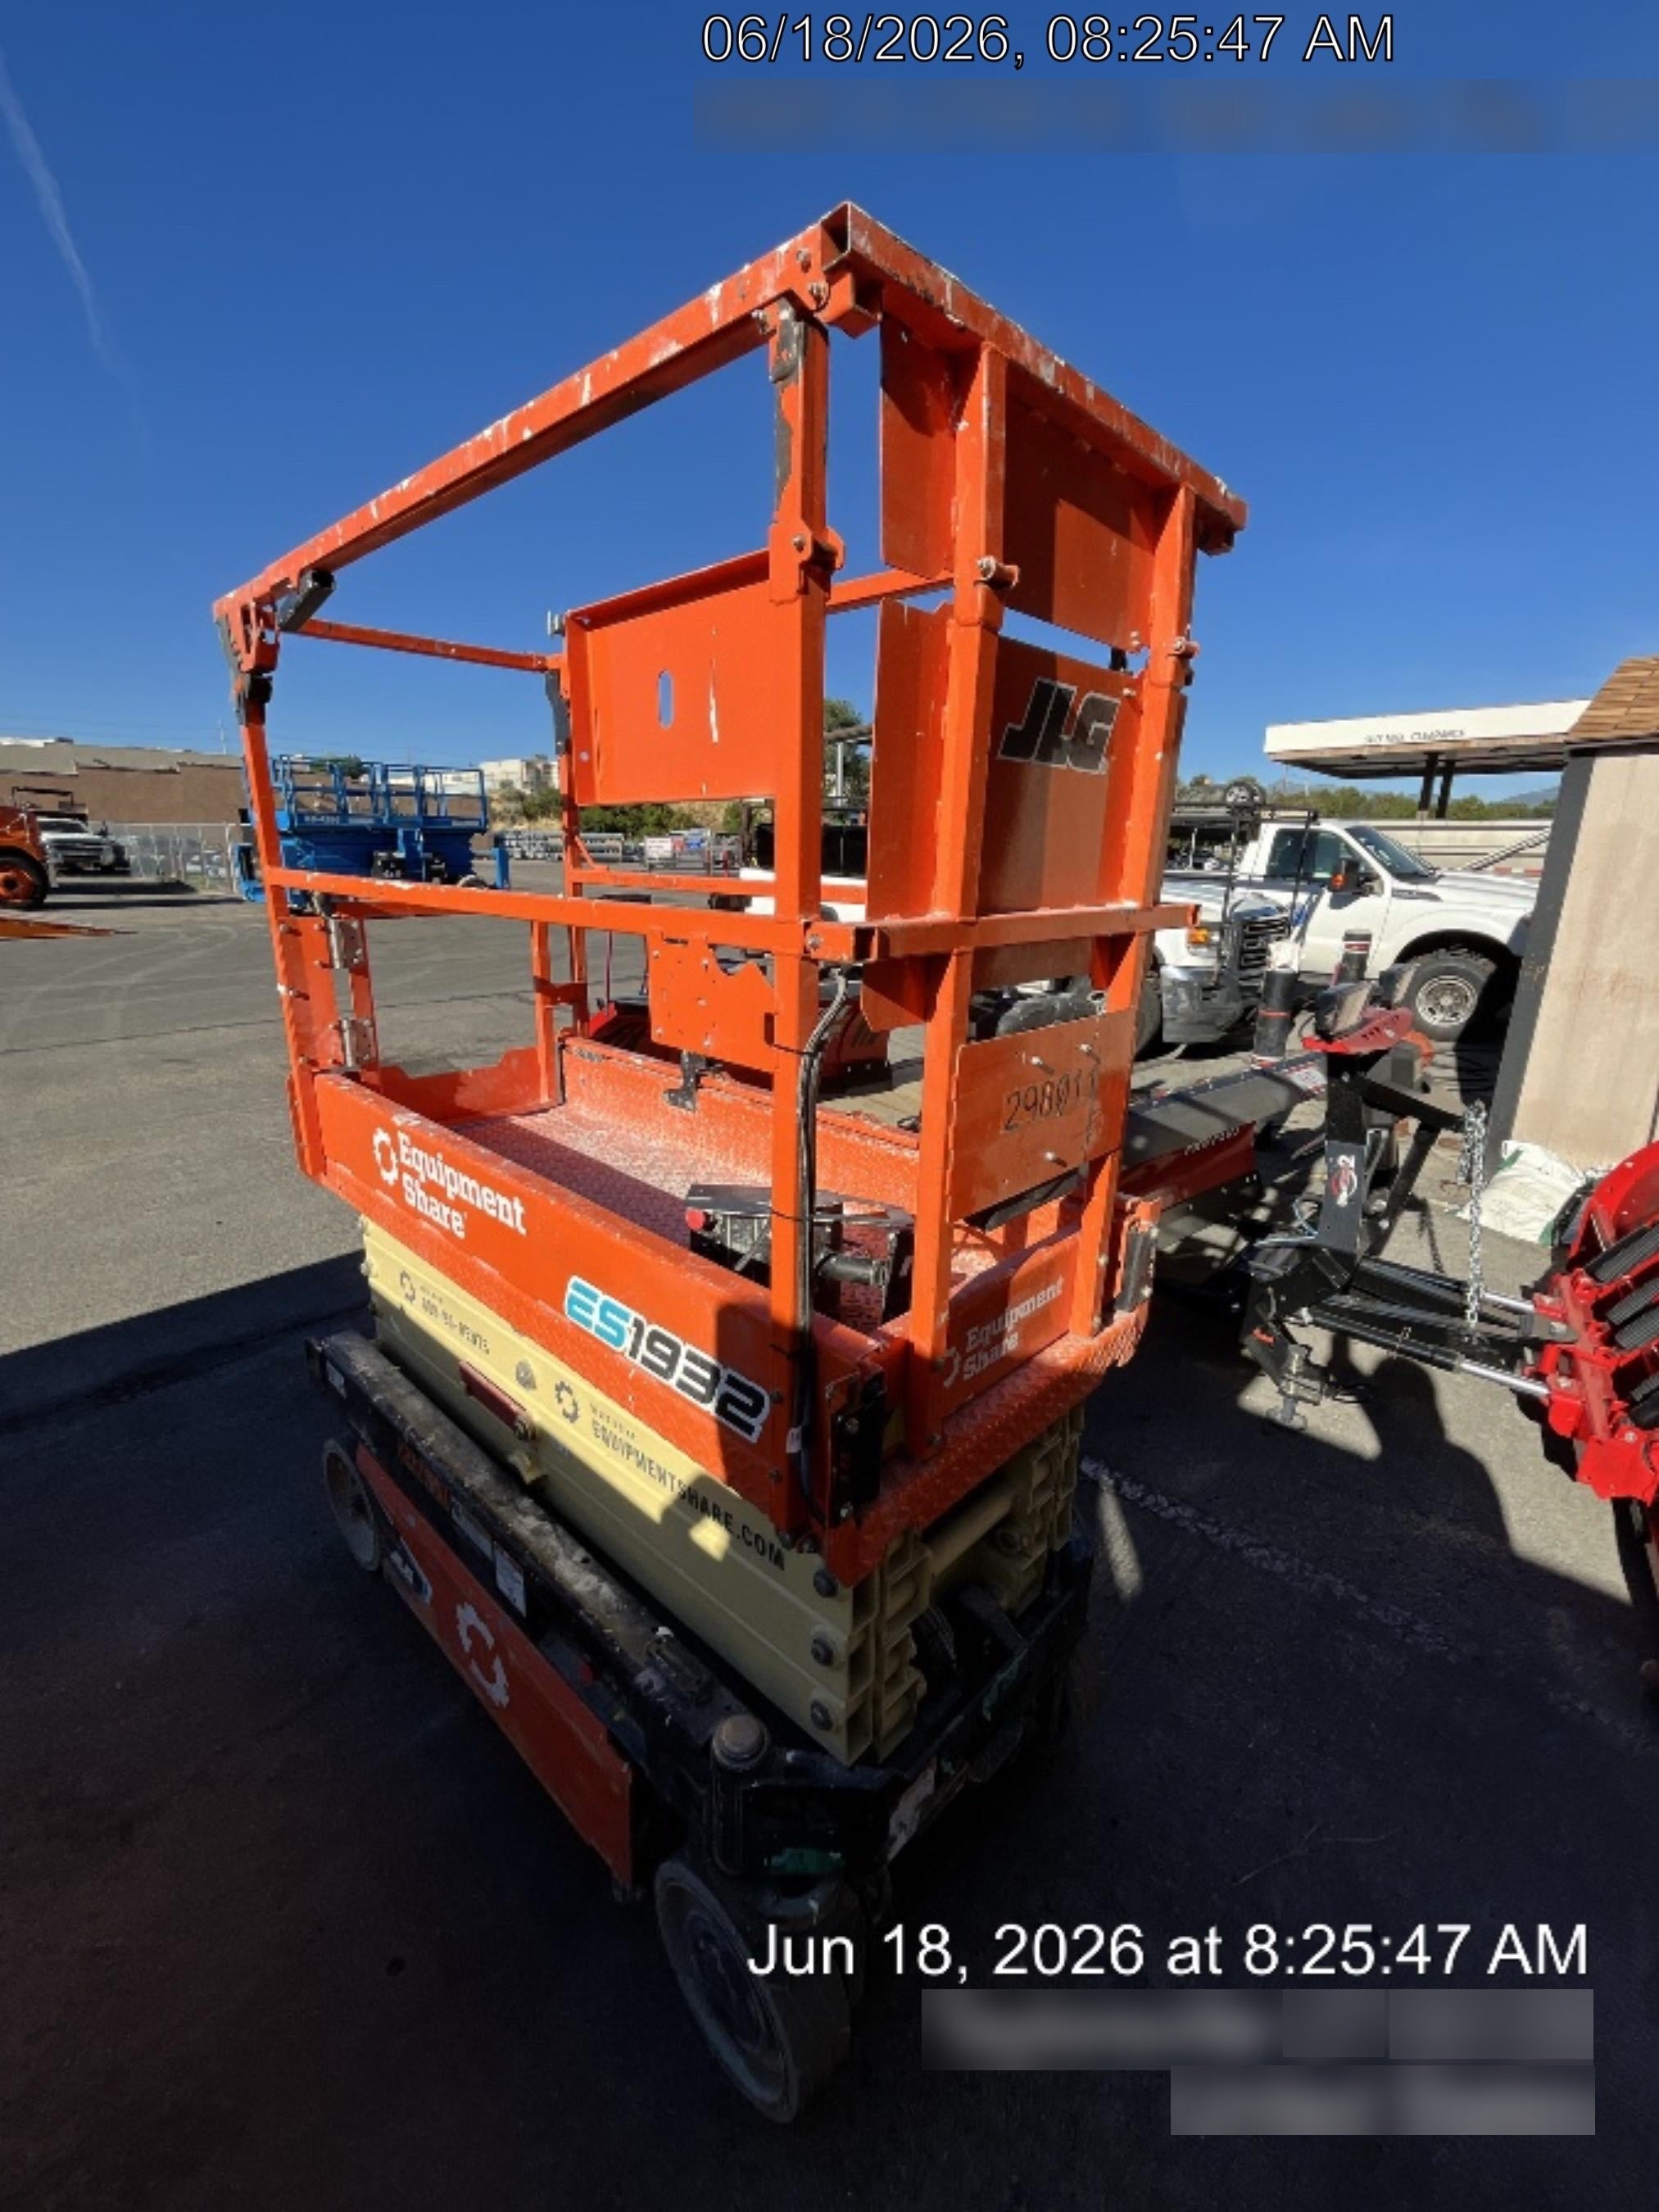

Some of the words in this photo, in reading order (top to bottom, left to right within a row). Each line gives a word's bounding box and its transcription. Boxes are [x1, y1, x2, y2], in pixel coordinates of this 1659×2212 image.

[997, 677, 1121, 775] JLG
[397, 1129, 528, 1237] Equipment
[401, 1172, 466, 1240] Share
[564, 1274, 772, 1444] ES1932
[961, 1332, 1019, 1381] Share
[966, 1274, 1065, 1352] Equipment
[590, 1418, 786, 1571] EQUIPMENTSHARE.COM
